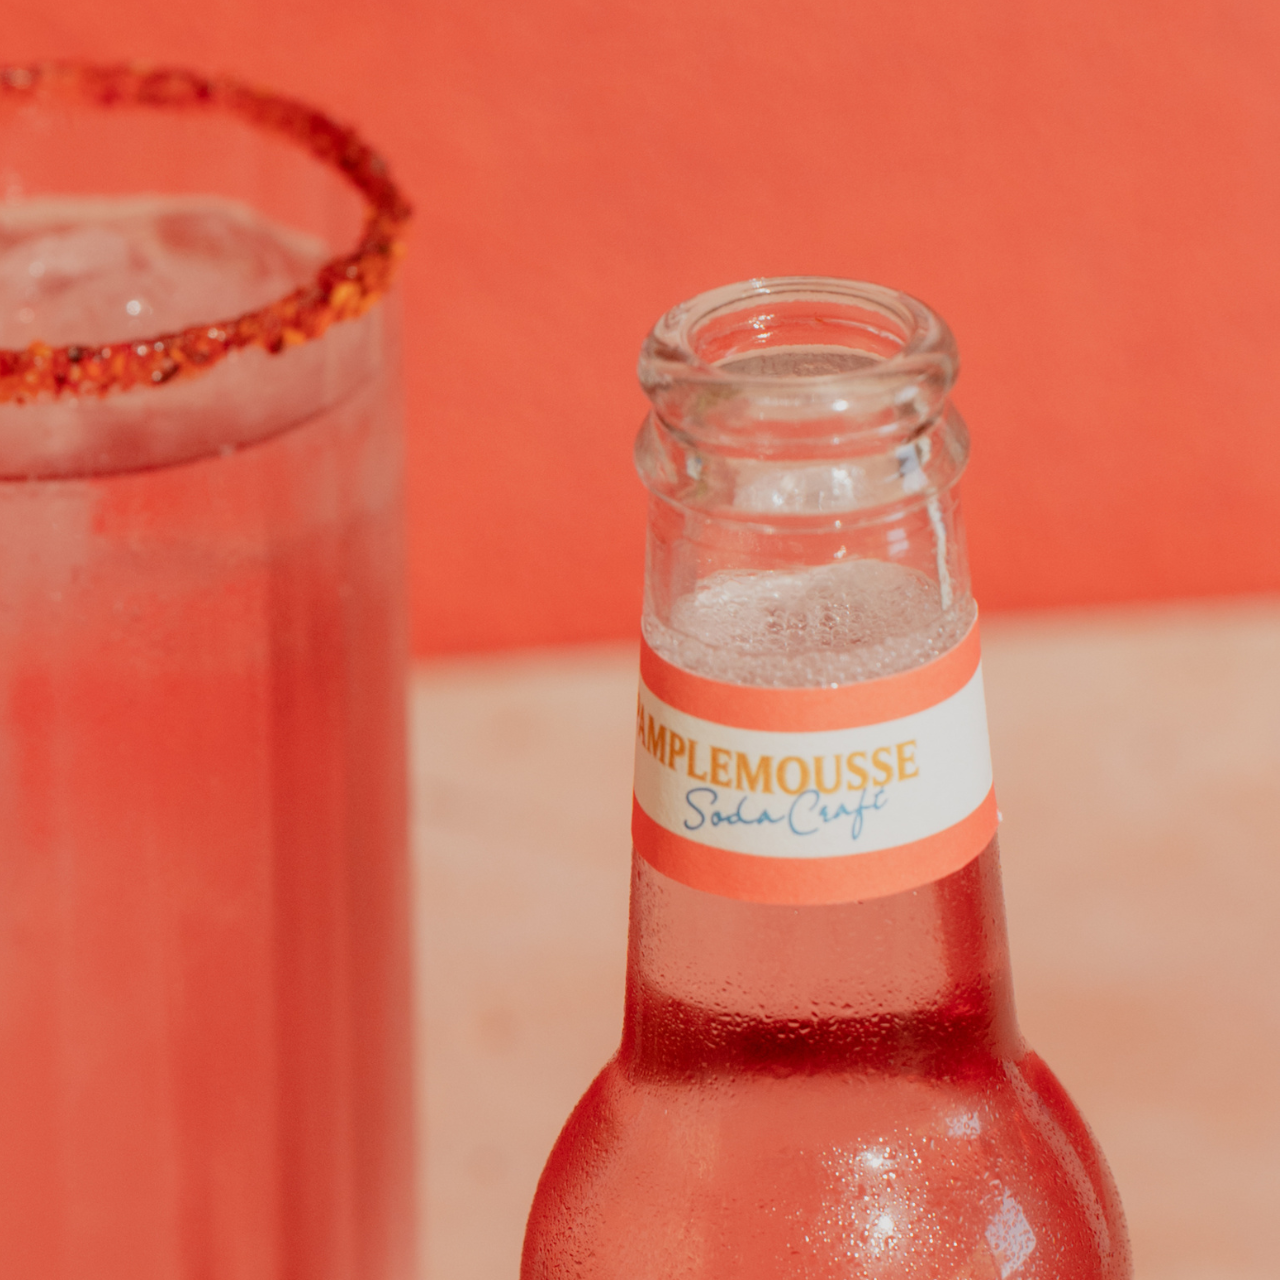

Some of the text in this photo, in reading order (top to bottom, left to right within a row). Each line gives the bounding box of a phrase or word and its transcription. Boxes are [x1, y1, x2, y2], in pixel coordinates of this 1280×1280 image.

[636, 691, 920, 796] AMPLEMOUSSE
[684, 785, 889, 841] Soda Craft
